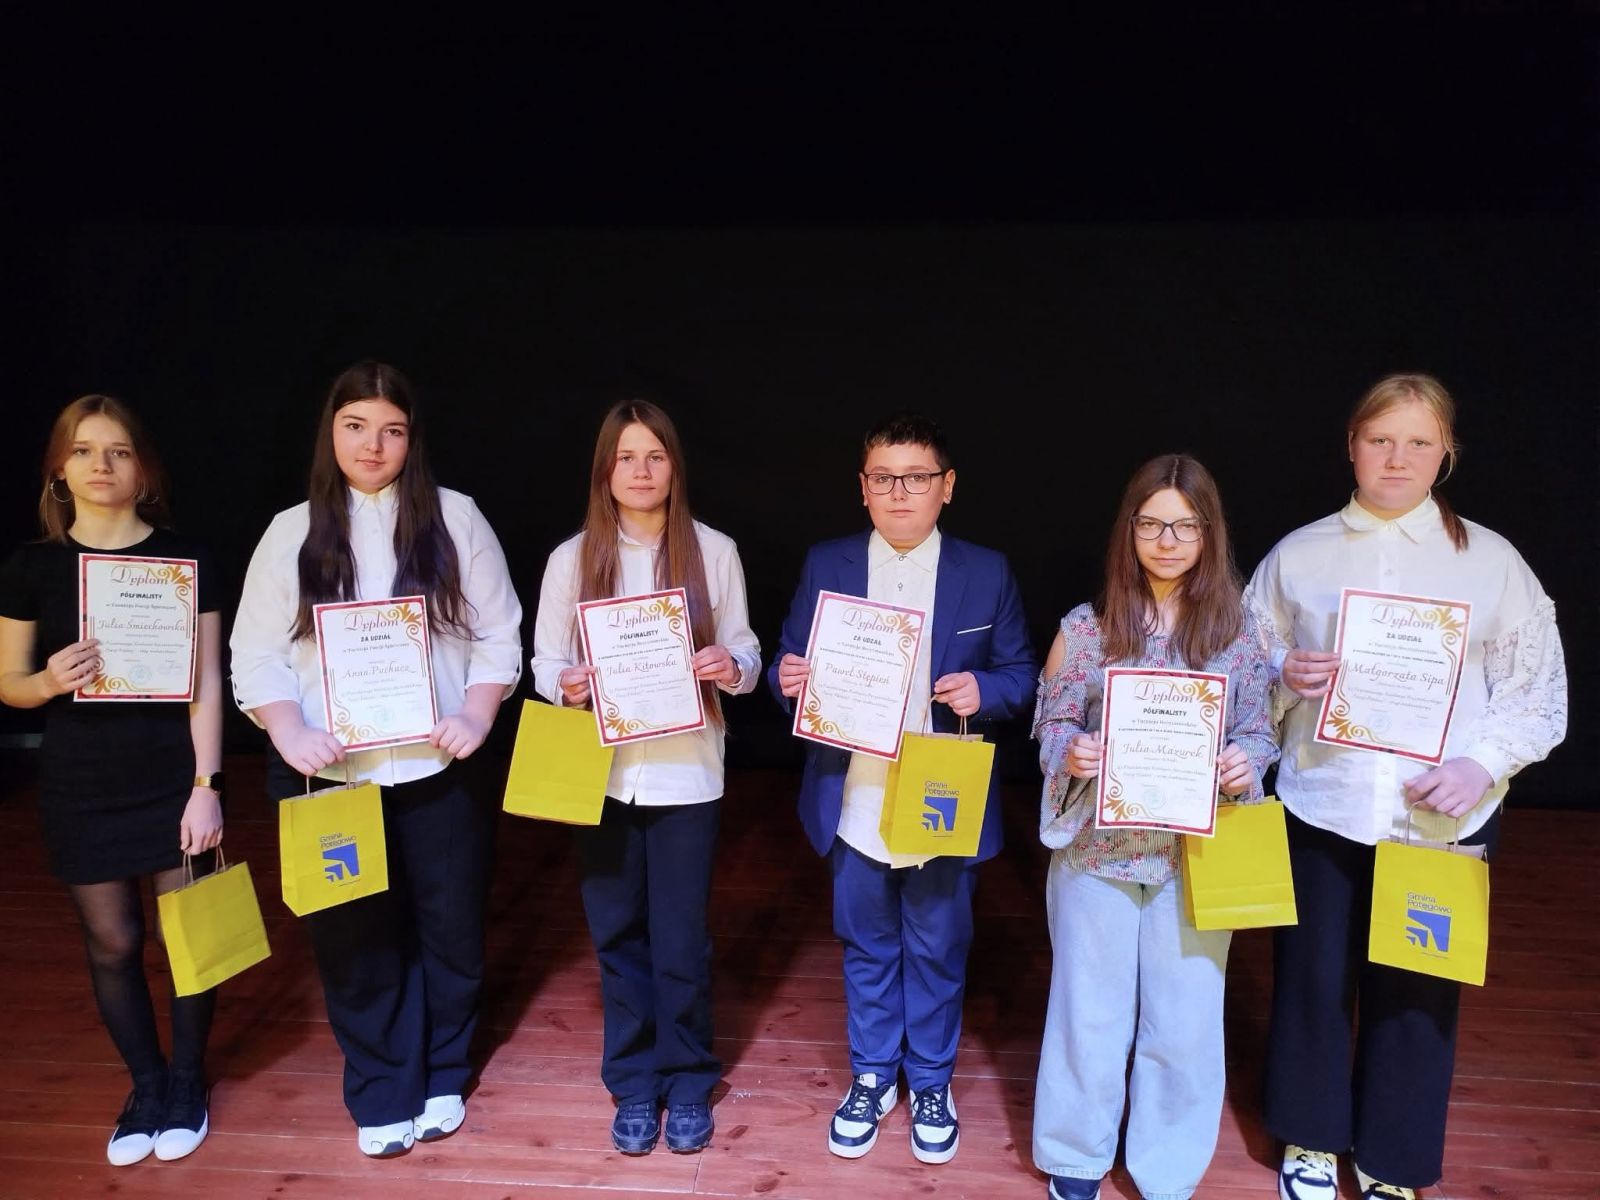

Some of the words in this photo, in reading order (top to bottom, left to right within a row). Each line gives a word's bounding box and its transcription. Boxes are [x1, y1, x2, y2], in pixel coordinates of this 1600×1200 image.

[110, 565, 168, 586] Dyplom
[120, 591, 162, 599] PÓŁFINALISTY
[344, 611, 398, 632] Dyplom
[607, 605, 660, 628] Dyplom
[842, 607, 894, 634] Dyplom
[1369, 603, 1434, 629] Dyplom
[620, 629, 659, 640] PÓŁFINALISTY
[1398, 634, 1422, 642] UDZIAŁ
[1349, 662, 1417, 682] Małgorzata
[1420, 673, 1443, 690] Sipa
[1134, 681, 1193, 704] Dyplom
[1143, 708, 1187, 717] PÓŁFINALISTY
[1122, 740, 1150, 754] Julia
[1154, 744, 1206, 759] Mazurek
[1408, 892, 1436, 902] Gmina
